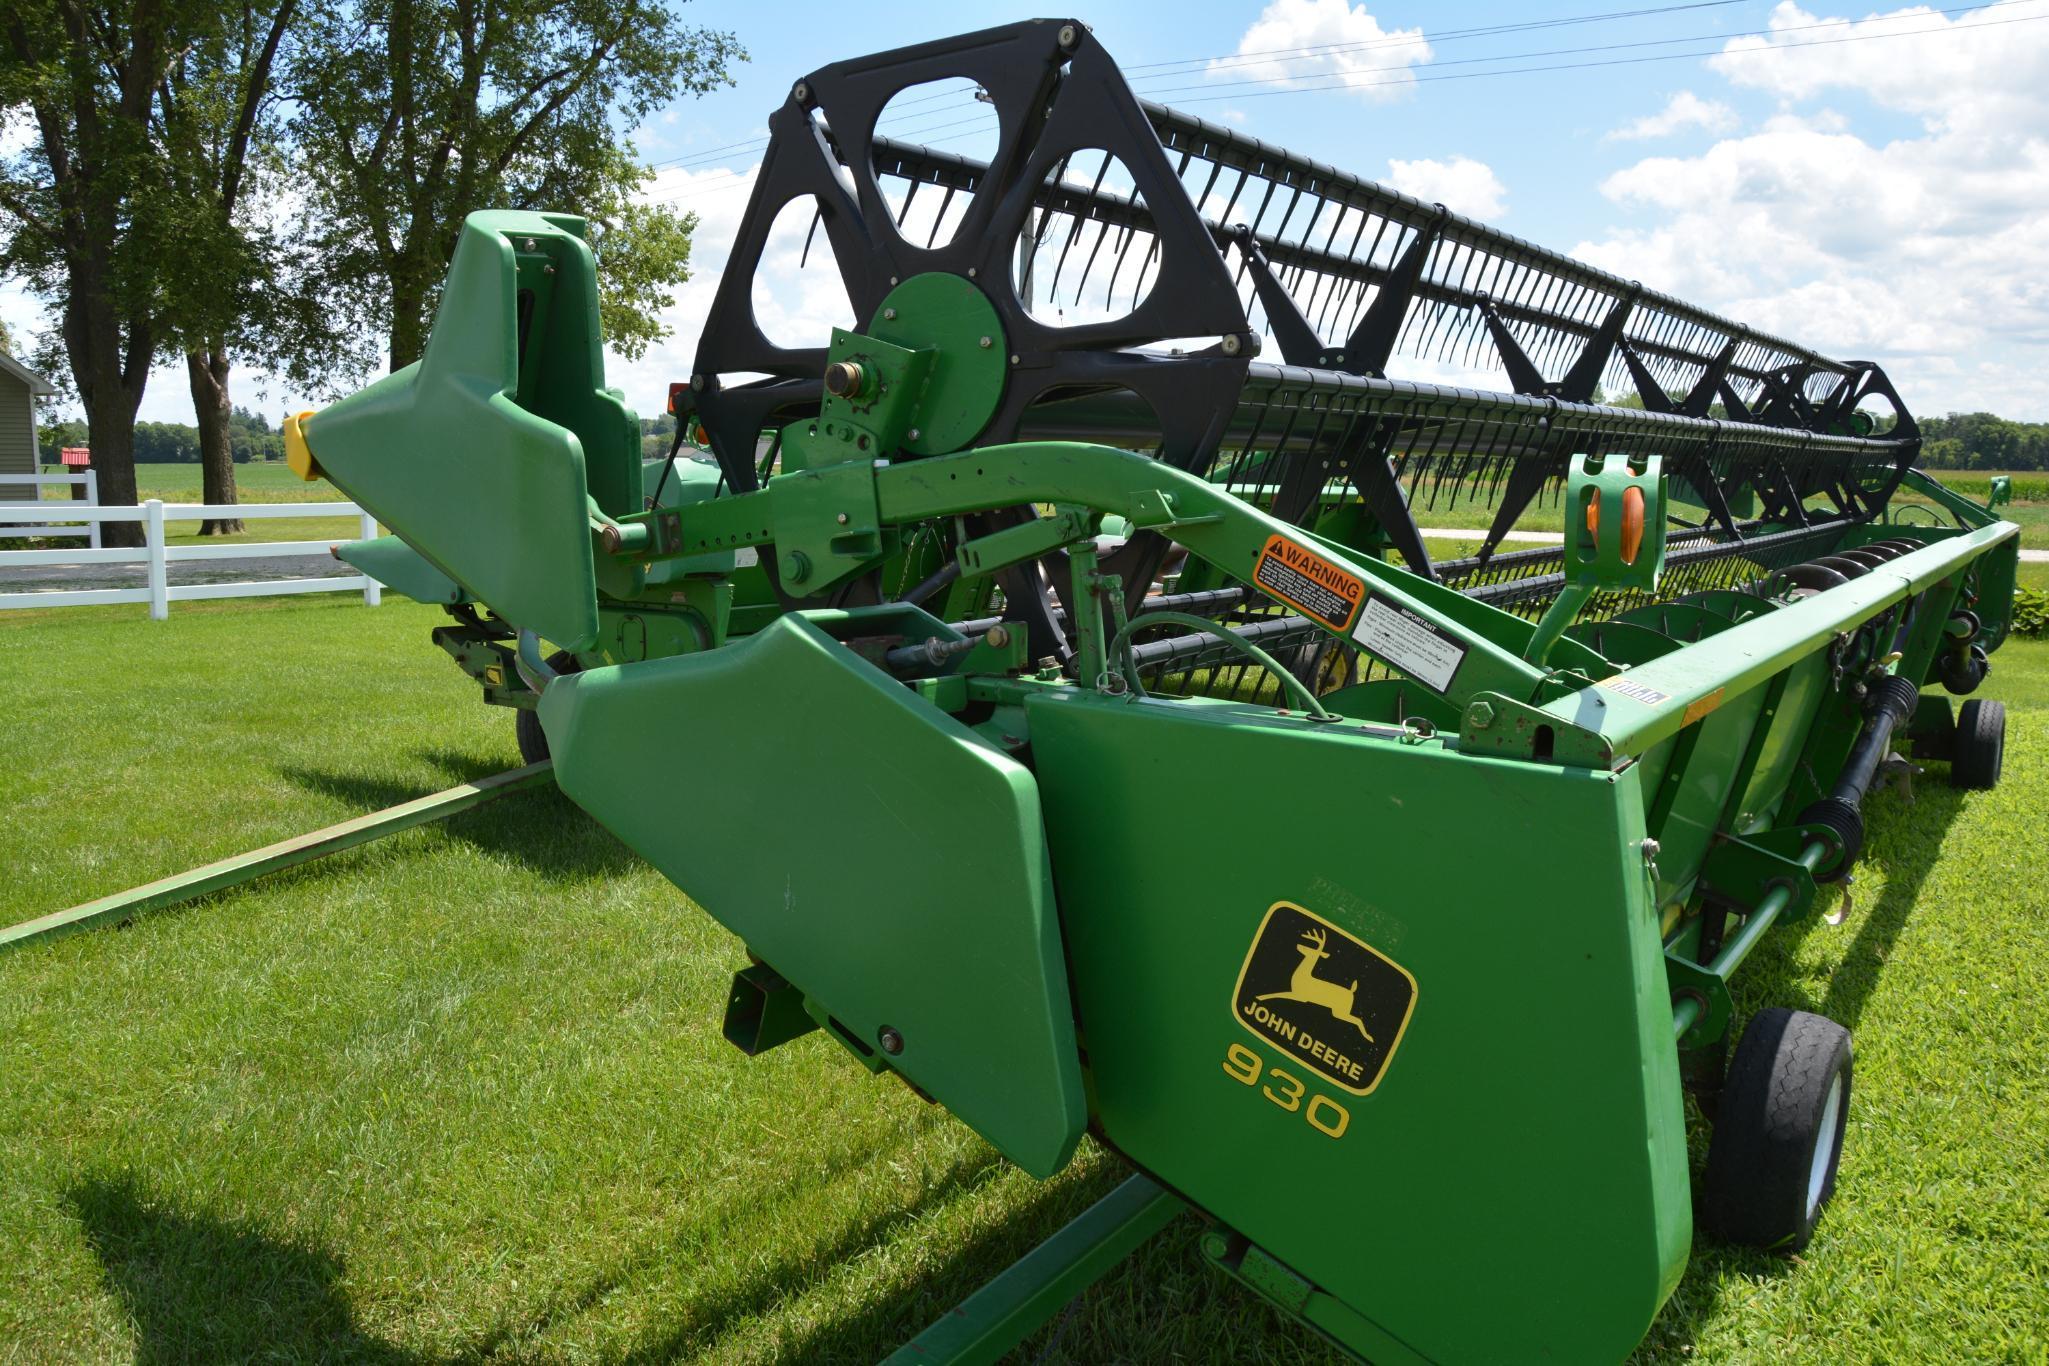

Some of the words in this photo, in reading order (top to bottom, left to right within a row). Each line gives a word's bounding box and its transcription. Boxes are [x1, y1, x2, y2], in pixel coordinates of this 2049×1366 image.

[1286, 546, 1360, 600] WARNING
[1401, 608, 1437, 632] IMPORTANT
[1243, 1001, 1297, 1042] JOHN
[1297, 1031, 1364, 1081] DEERE
[1222, 1042, 1350, 1140] 930
